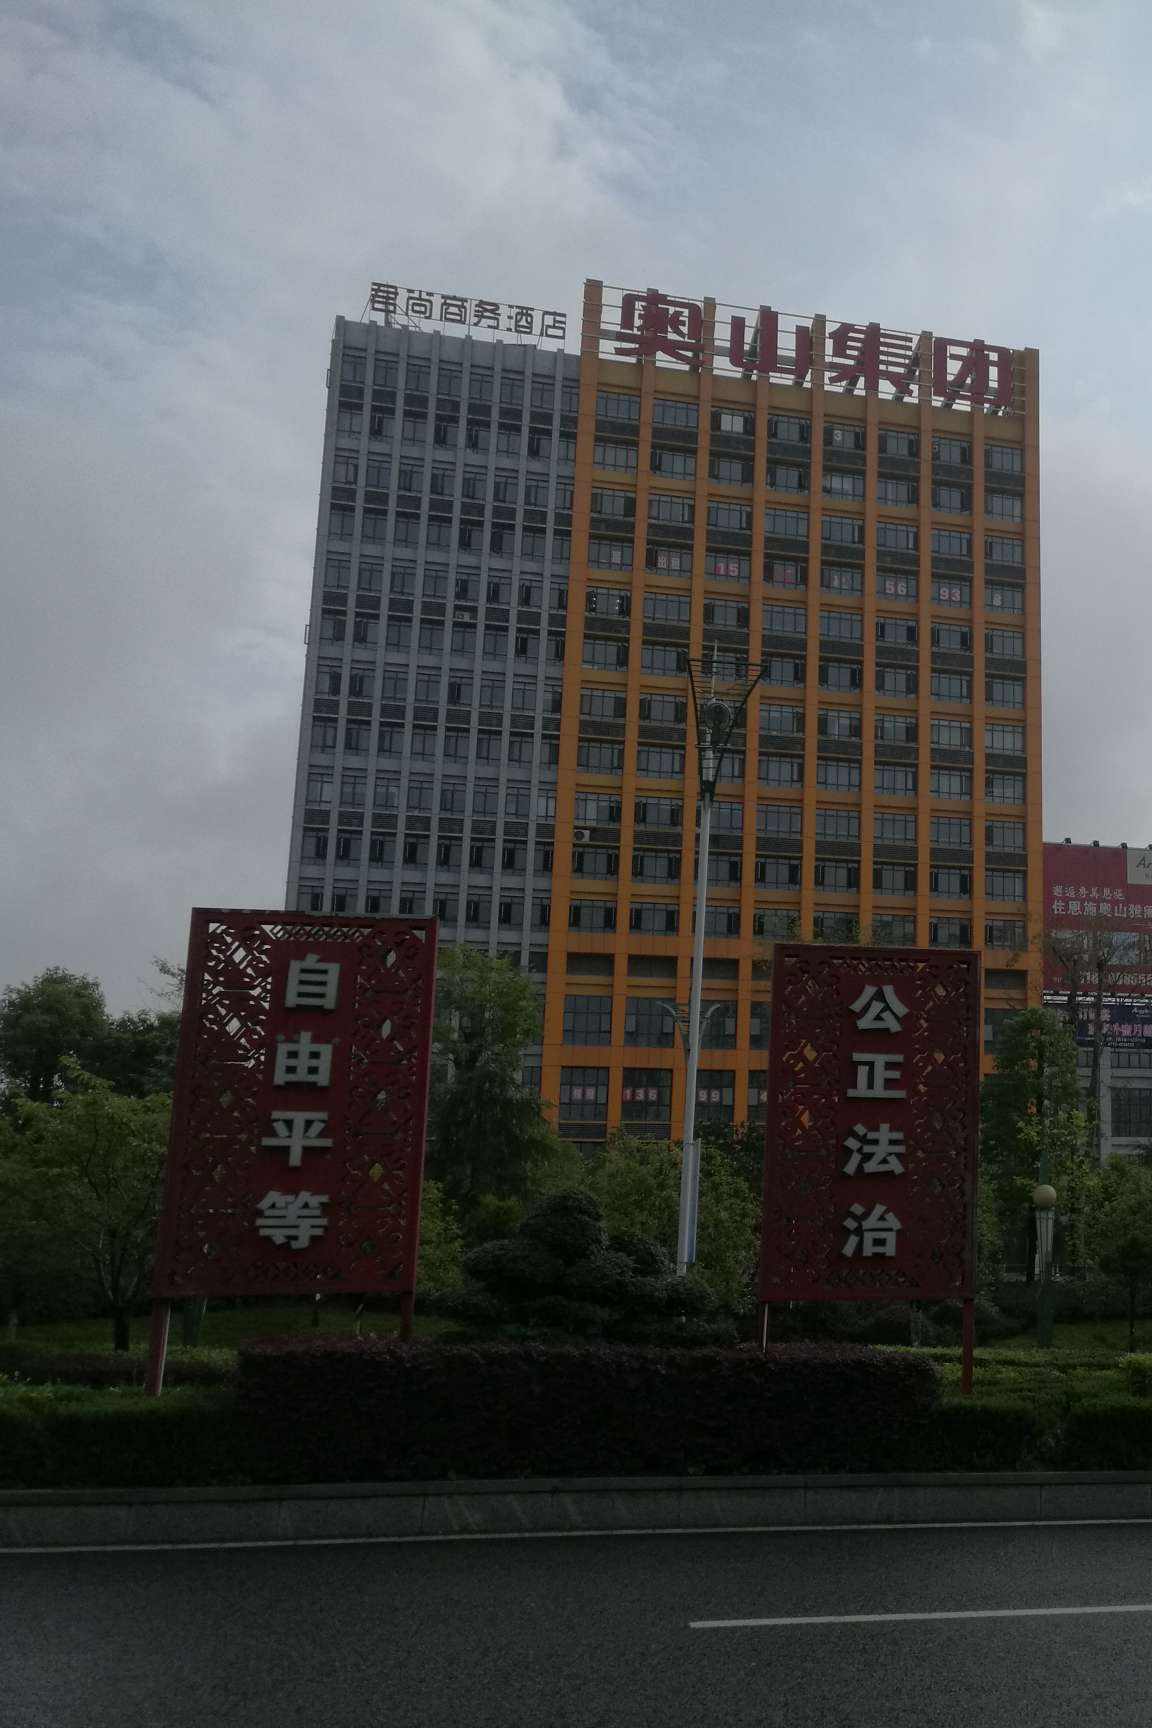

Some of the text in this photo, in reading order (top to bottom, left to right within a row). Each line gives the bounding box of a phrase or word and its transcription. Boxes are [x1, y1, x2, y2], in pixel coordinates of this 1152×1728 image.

[614, 292, 1014, 404] 奥山集团
[255, 953, 342, 1250] 自由平等
[841, 984, 911, 1258] 公正法治
